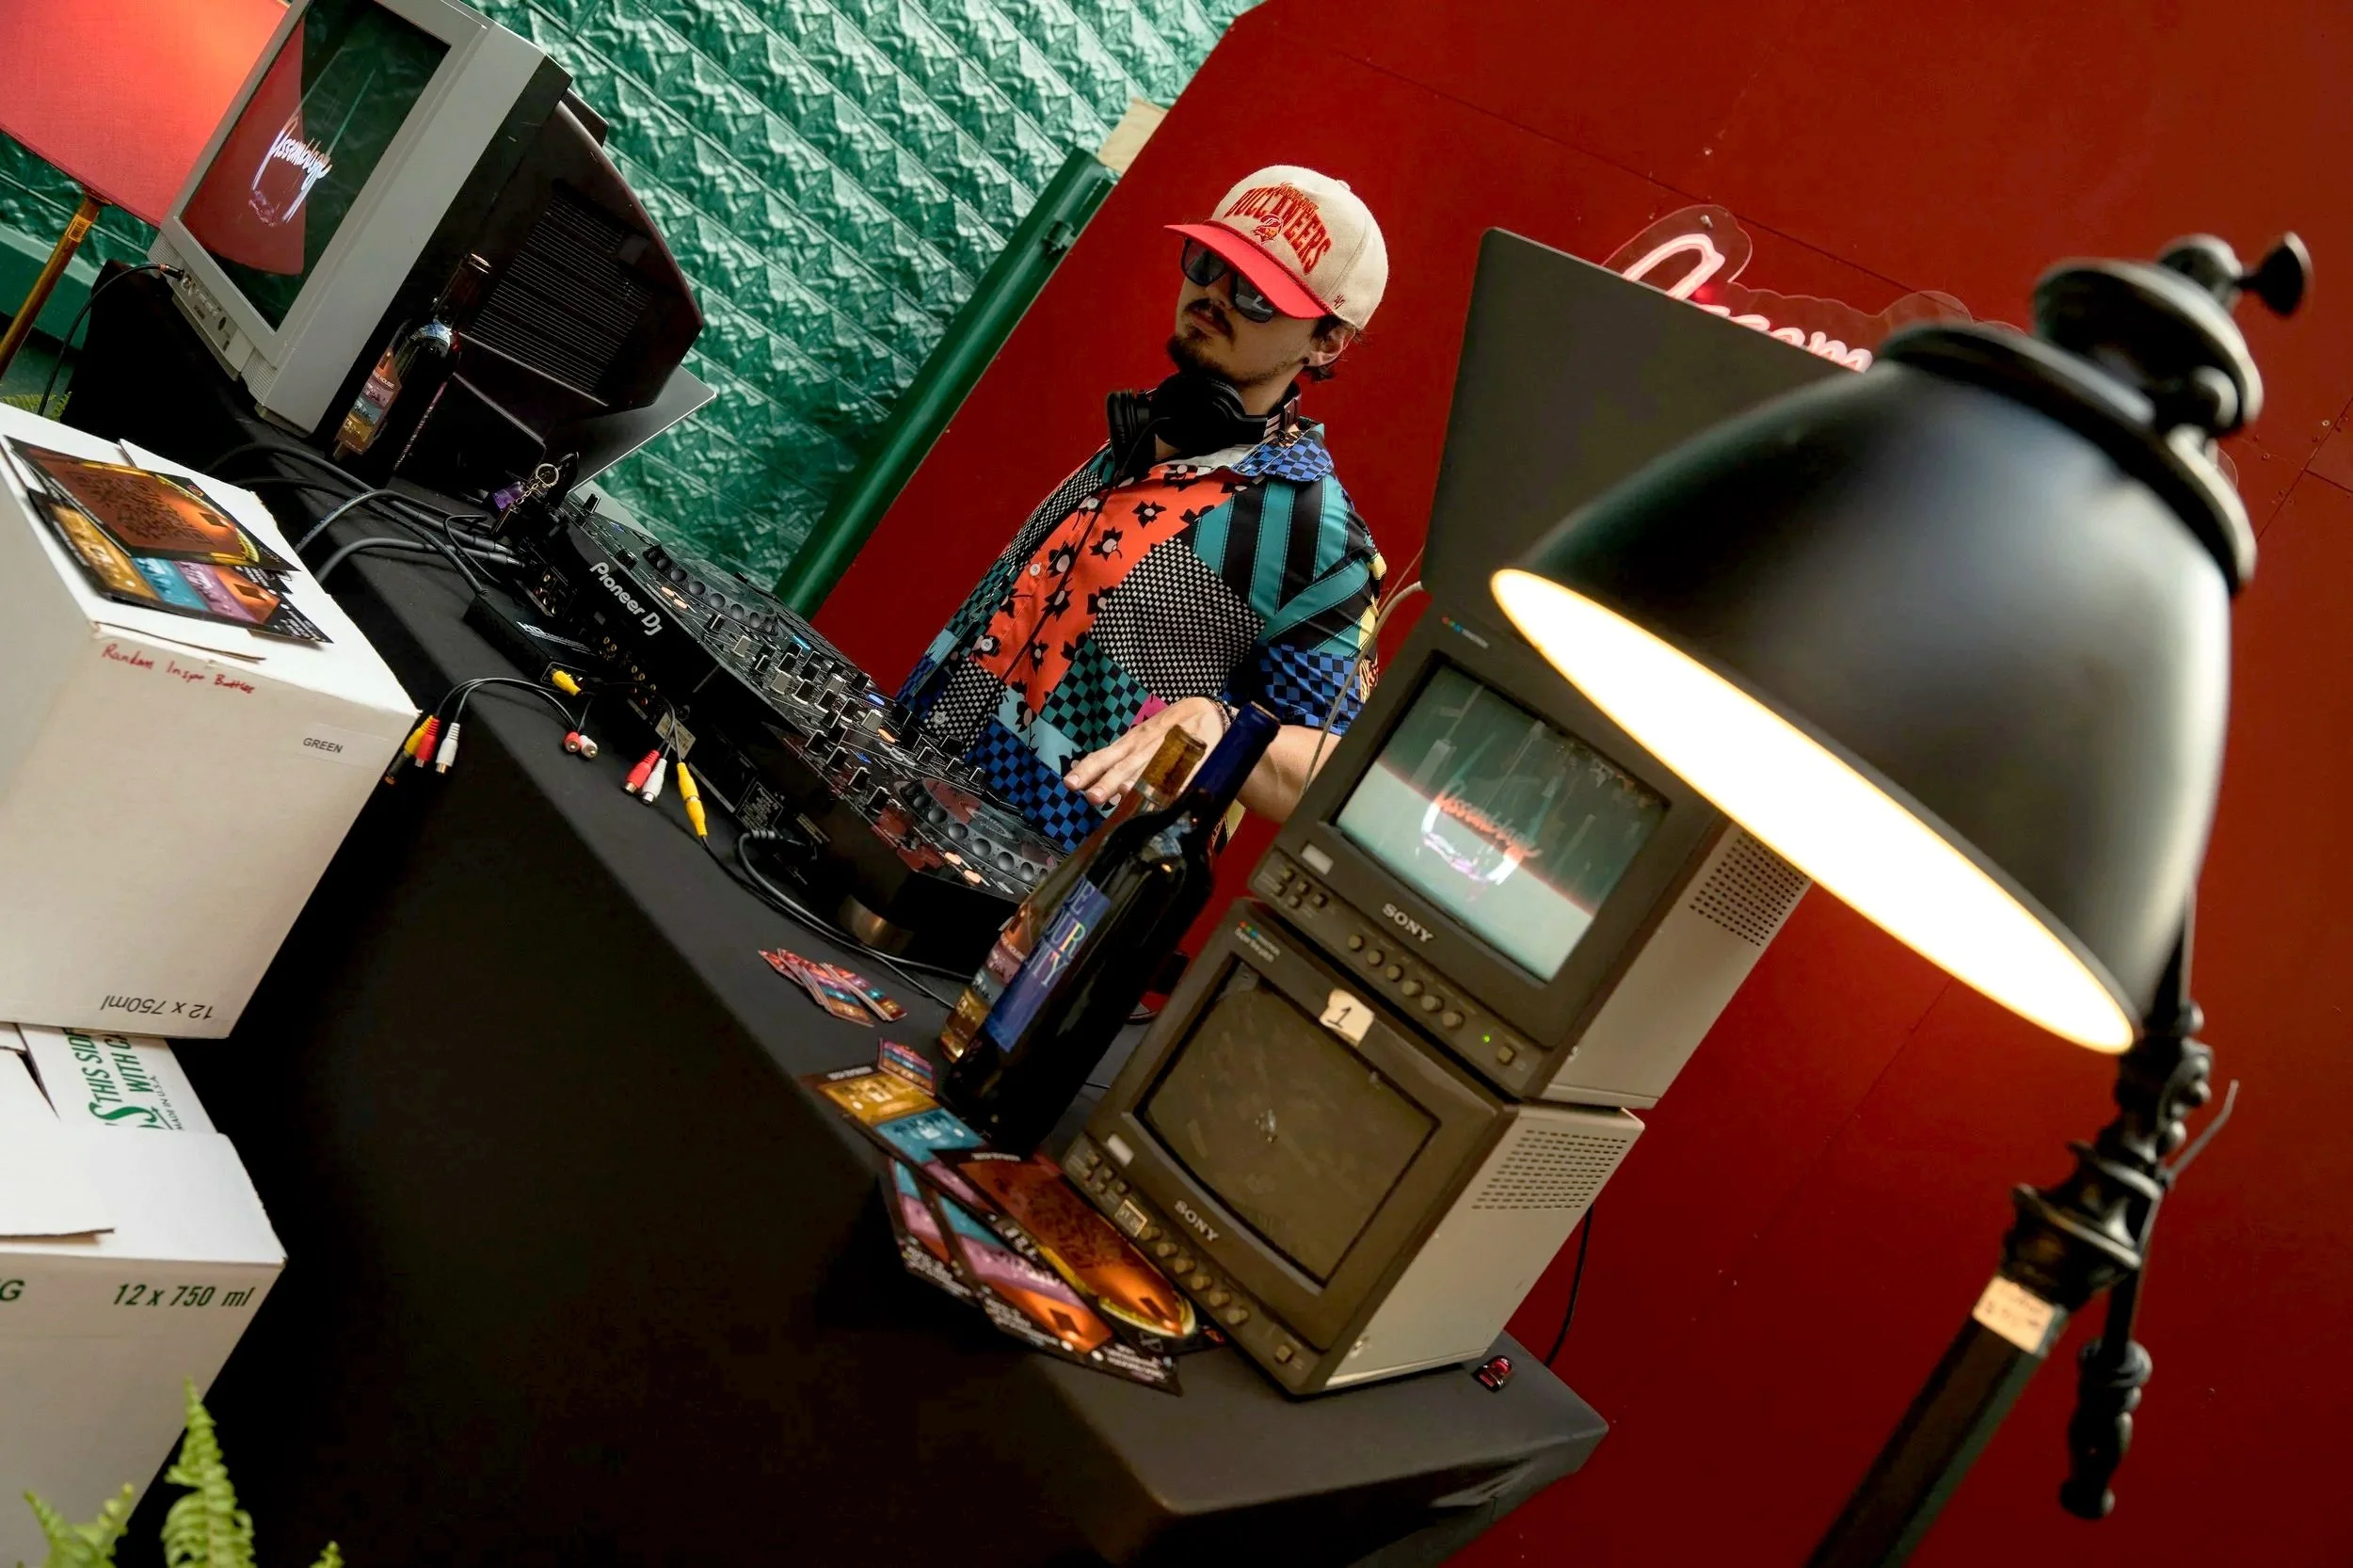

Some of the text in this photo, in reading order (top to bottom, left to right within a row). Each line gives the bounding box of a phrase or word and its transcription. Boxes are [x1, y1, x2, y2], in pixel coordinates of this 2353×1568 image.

[589, 562, 645, 616] Pioneer
[302, 737, 344, 754] GREEN
[1382, 903, 1434, 943] SONY
[100, 995, 214, 1020] 12 x 750ml
[1326, 1006, 1353, 1030] 1
[81, 1066, 123, 1103] THIS
[110, 1052, 154, 1093] WITH
[1175, 1200, 1220, 1242] SONY
[0, 1278, 256, 1307] G 12 x 750 ml
